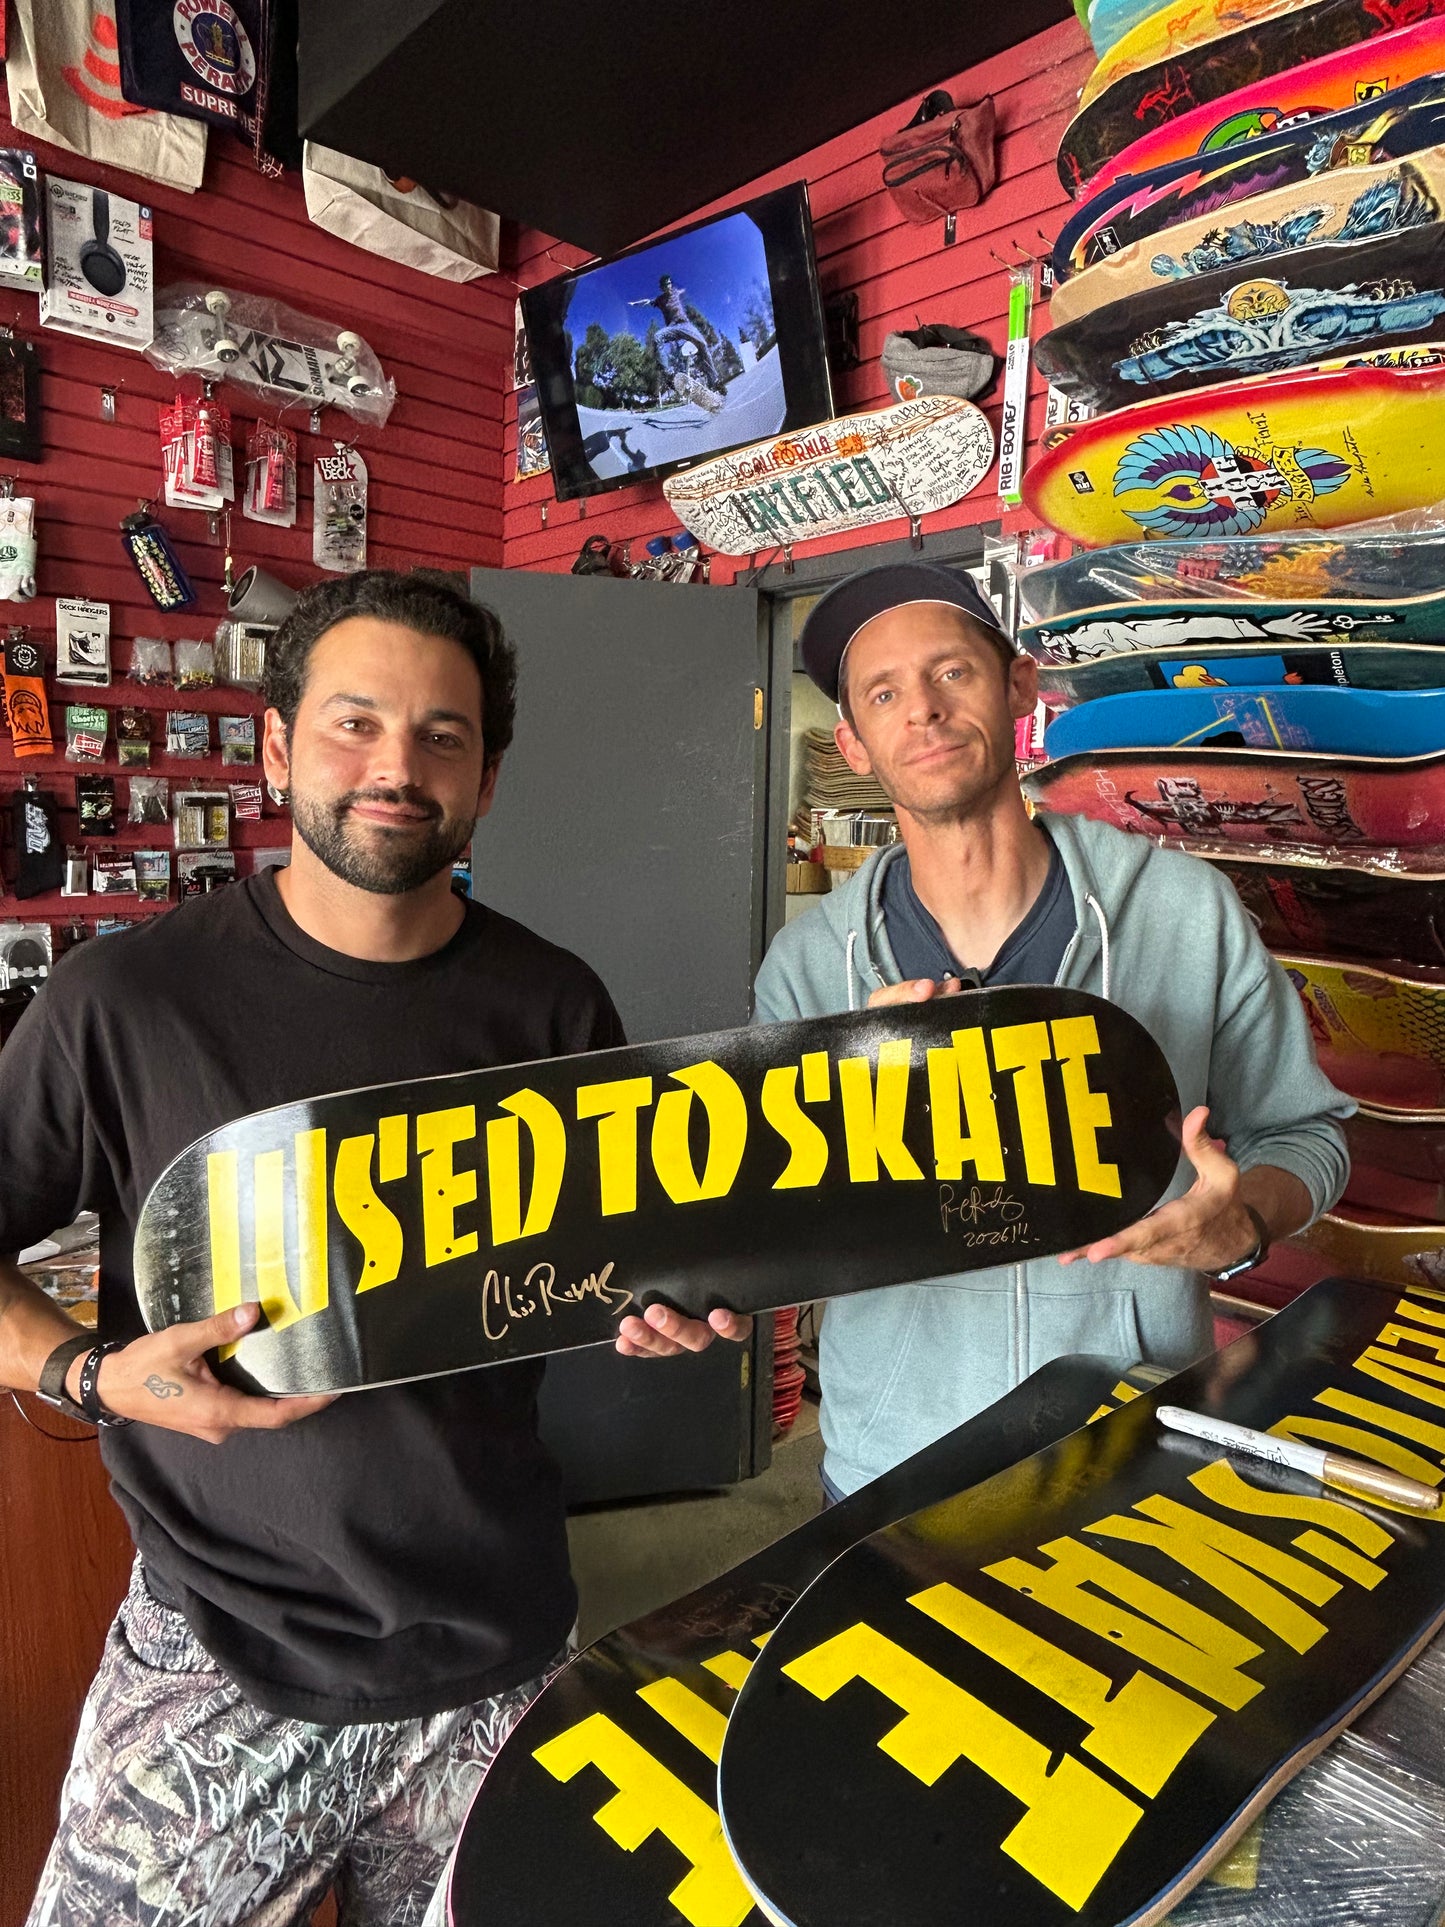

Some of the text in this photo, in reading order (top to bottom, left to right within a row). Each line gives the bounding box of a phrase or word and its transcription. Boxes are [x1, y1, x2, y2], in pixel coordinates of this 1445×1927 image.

[316, 456, 347, 470] TECH
[323, 467, 353, 481] DECK
[738, 434, 832, 480] CALIFORNIA
[1273, 450, 1312, 500] SKATES
[733, 455, 892, 535] UNIFIED
[59, 603, 77, 612] DECK
[206, 1014, 1123, 1363] USED TO SKATE
[780, 1458, 1397, 1913] SKATE
